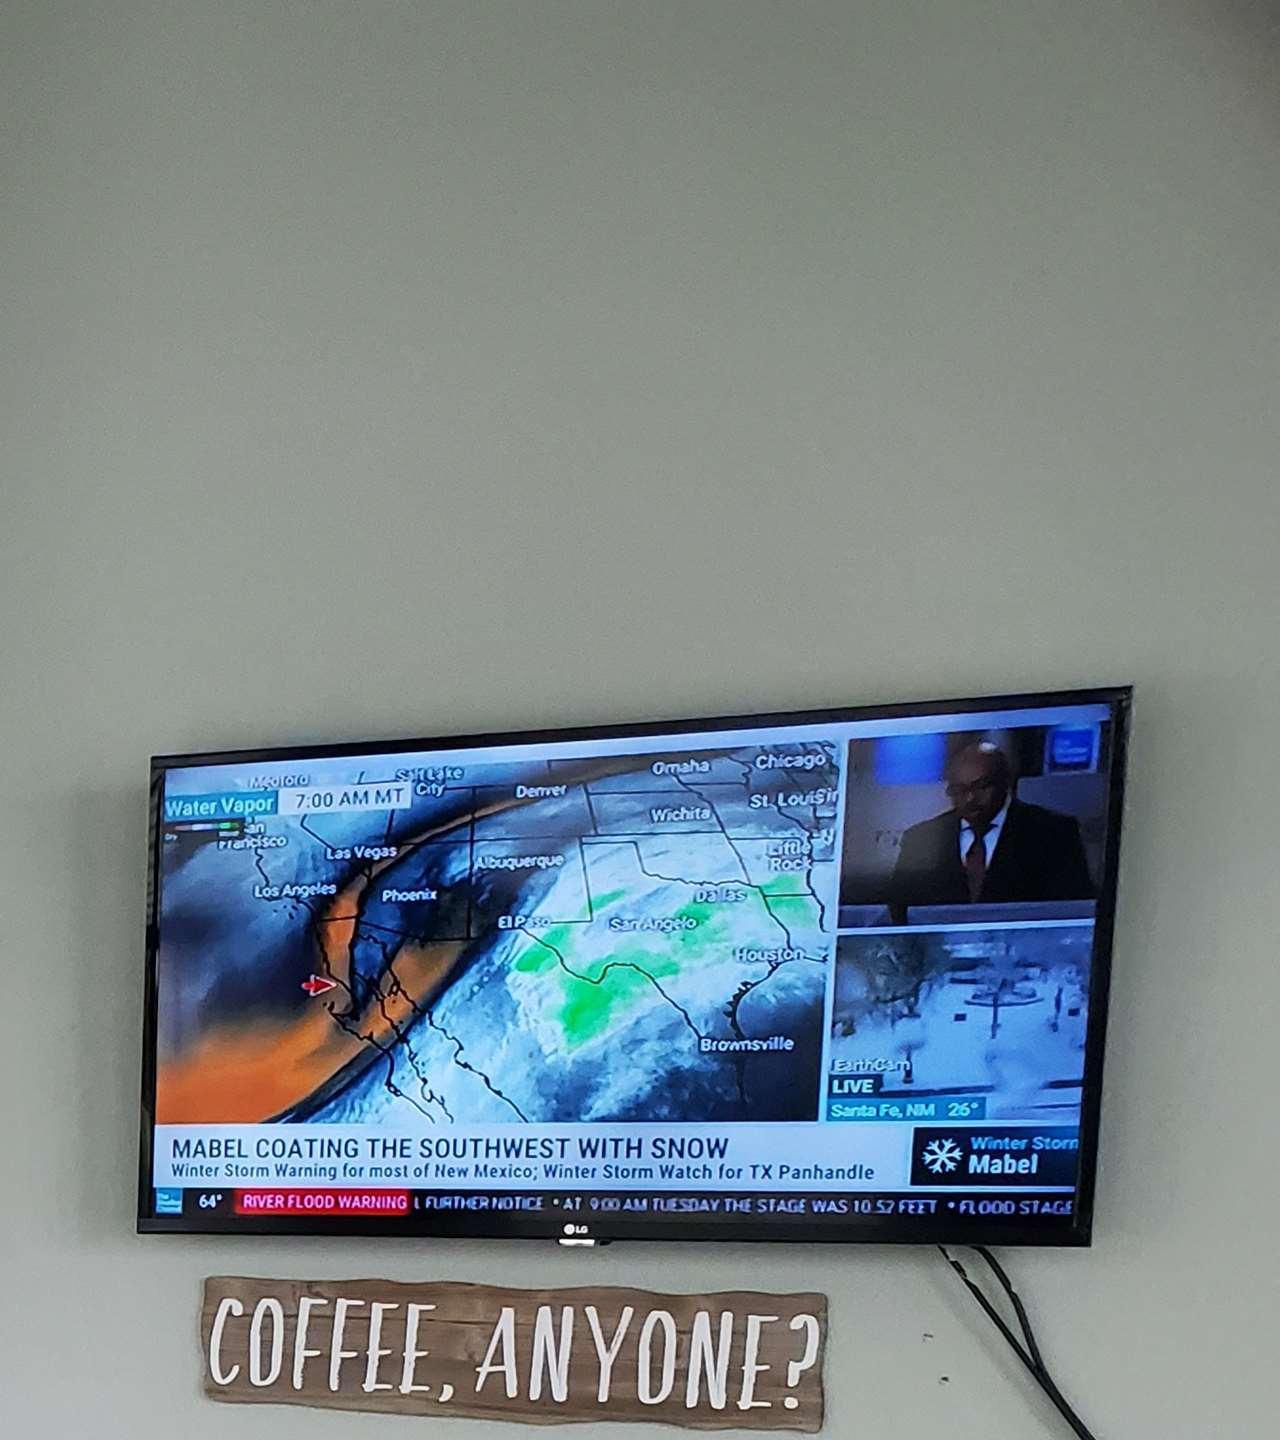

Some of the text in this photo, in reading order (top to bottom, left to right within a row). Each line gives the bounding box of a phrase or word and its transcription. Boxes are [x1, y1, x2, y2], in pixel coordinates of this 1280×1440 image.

[651, 758, 711, 775] Omaha
[756, 754, 826, 769] Chicago
[416, 782, 446, 797] City
[516, 784, 567, 798] Denver
[296, 788, 404, 809] 7:00 AM MT
[166, 797, 274, 817] Water Vapor
[650, 806, 711, 821] Wichita
[326, 846, 397, 860] Las Vegas
[475, 854, 564, 870] Albuquerque
[770, 857, 812, 871] Rock
[255, 882, 337, 900] Los Angeles
[382, 888, 438, 904] Phoenix
[498, 915, 551, 928] El Paso
[610, 916, 698, 932] San Angelo
[735, 949, 806, 963] Houston
[700, 1037, 795, 1053] Brownsville
[831, 1079, 874, 1094] LIVE
[831, 1104, 876, 1118] Santa
[906, 1103, 935, 1117] NM
[948, 1102, 979, 1117] 26°
[172, 1137, 730, 1160] MABEL COATING THE SOUTHWEST WITH SNOW
[971, 1136, 1027, 1150] Winter
[171, 1162, 874, 1181] Winter Storm Warning for most of New Mexico; Winter Storm Watch for TX Panhandle
[969, 1153, 1039, 1174] Mabel
[243, 1195, 284, 1208] RIVER
[288, 1195, 335, 1208] FLOOD
[338, 1195, 408, 1209] WARNING
[426, 1197, 489, 1210] FURTHER
[493, 1197, 543, 1210] NOTICE
[564, 1198, 581, 1211] AT
[624, 1198, 648, 1211] AM
[653, 1198, 719, 1212] TUESDAY
[724, 1199, 751, 1213] THE
[758, 1199, 806, 1213] STAGE
[812, 1199, 848, 1213] WAS
[899, 1200, 936, 1213] FEET
[959, 1200, 1015, 1214] FLOOD
[1019, 1200, 1073, 1215] STAGE
[208, 1297, 820, 1410] COFFEE, ANYONE?
